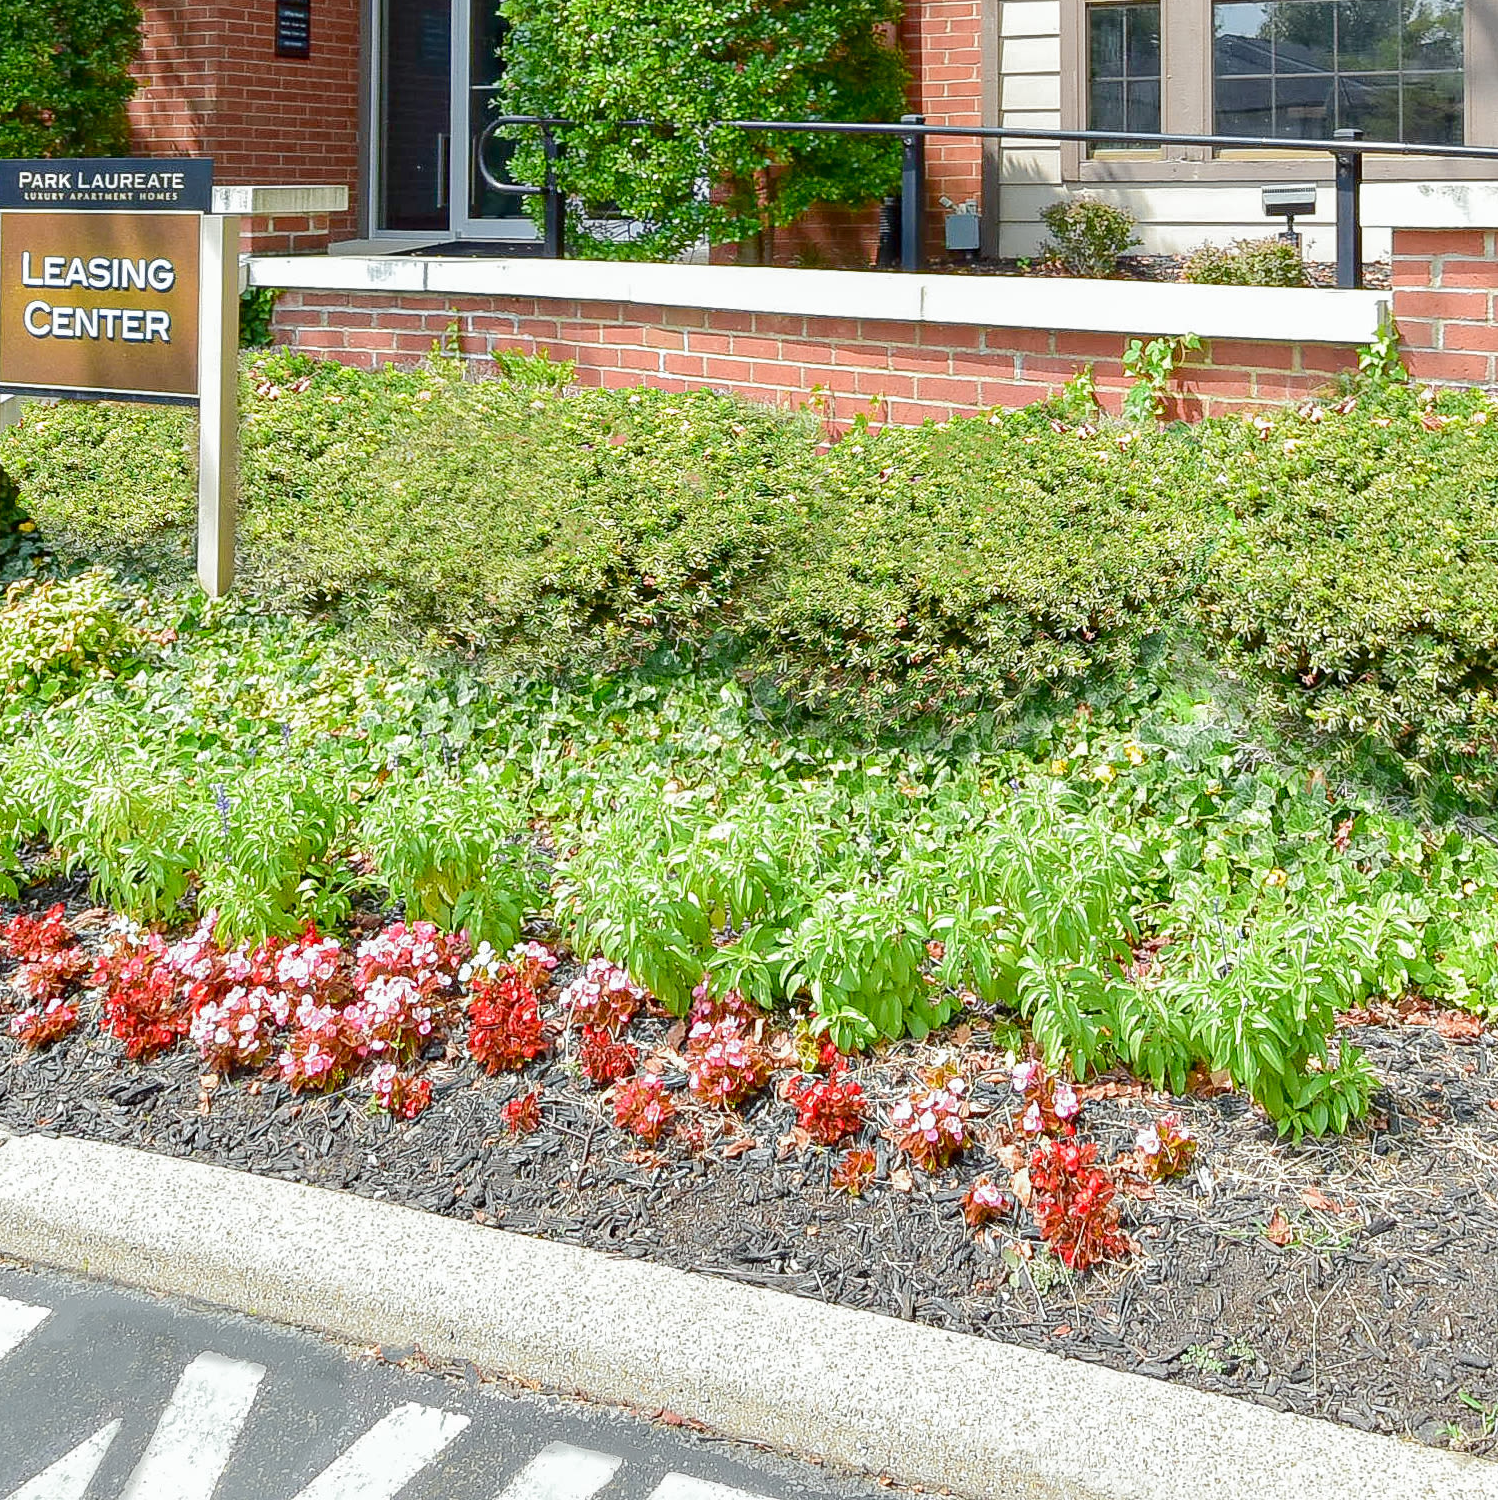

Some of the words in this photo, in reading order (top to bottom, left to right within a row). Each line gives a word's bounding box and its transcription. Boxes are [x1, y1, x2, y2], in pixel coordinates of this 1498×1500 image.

[18, 171, 72, 189] PARK
[77, 171, 185, 189] LAUREATE
[23, 192, 65, 201] LUXURY
[69, 192, 133, 201] APARTMENT
[139, 192, 178, 201] HOMES
[21, 250, 175, 291] LEASING
[23, 300, 170, 342] CENTER
